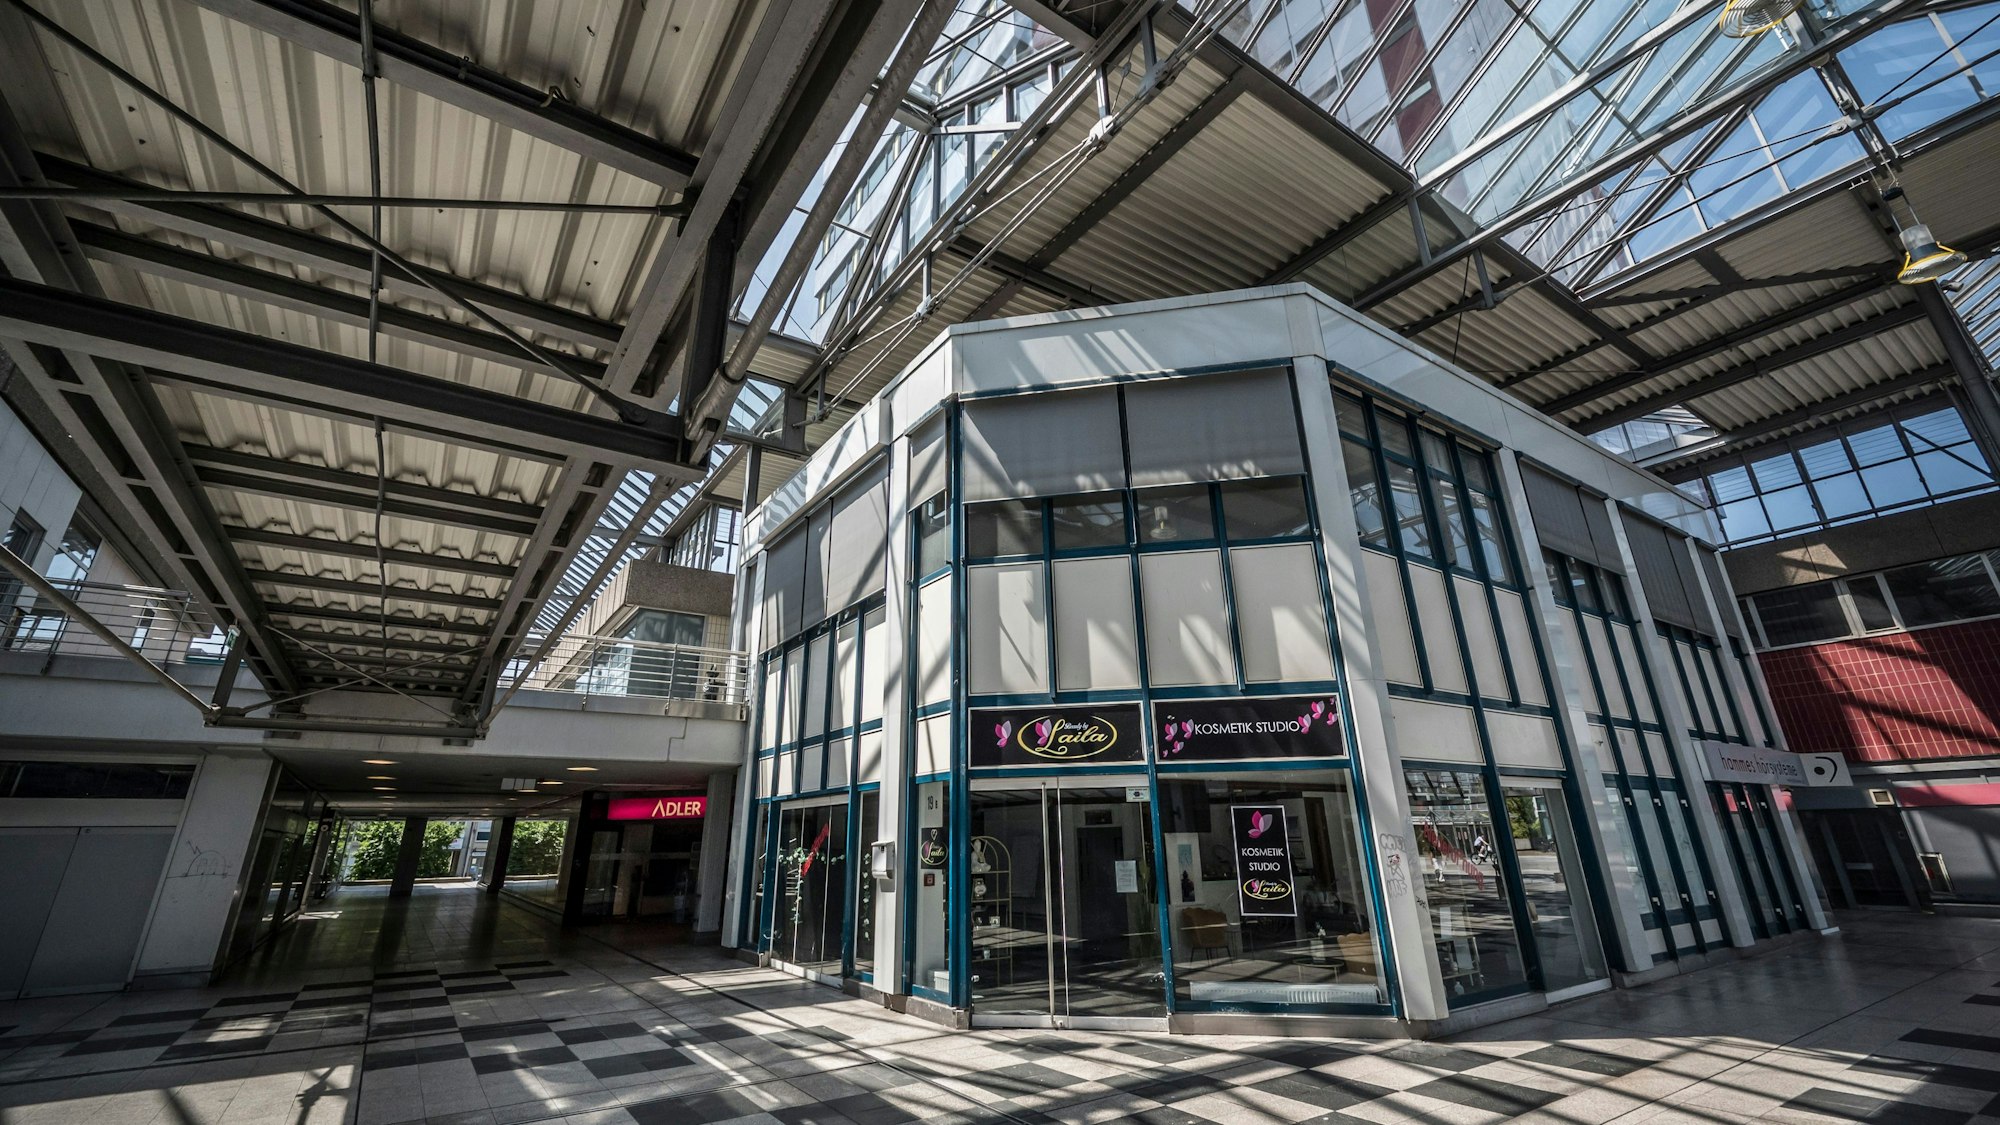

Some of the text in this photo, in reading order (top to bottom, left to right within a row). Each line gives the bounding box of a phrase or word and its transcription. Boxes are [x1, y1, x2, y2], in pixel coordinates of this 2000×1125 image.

[1194, 720, 1300, 735] KOSMETIK STUDIO
[1034, 718, 1109, 755] Laila
[1754, 753, 1798, 780] hörsysteme
[652, 799, 701, 817] ADLER
[927, 795, 934, 810] 19
[1241, 847, 1285, 857] KOSMETIK
[1248, 862, 1281, 872] STUDIO
[1252, 880, 1288, 898] Laila
